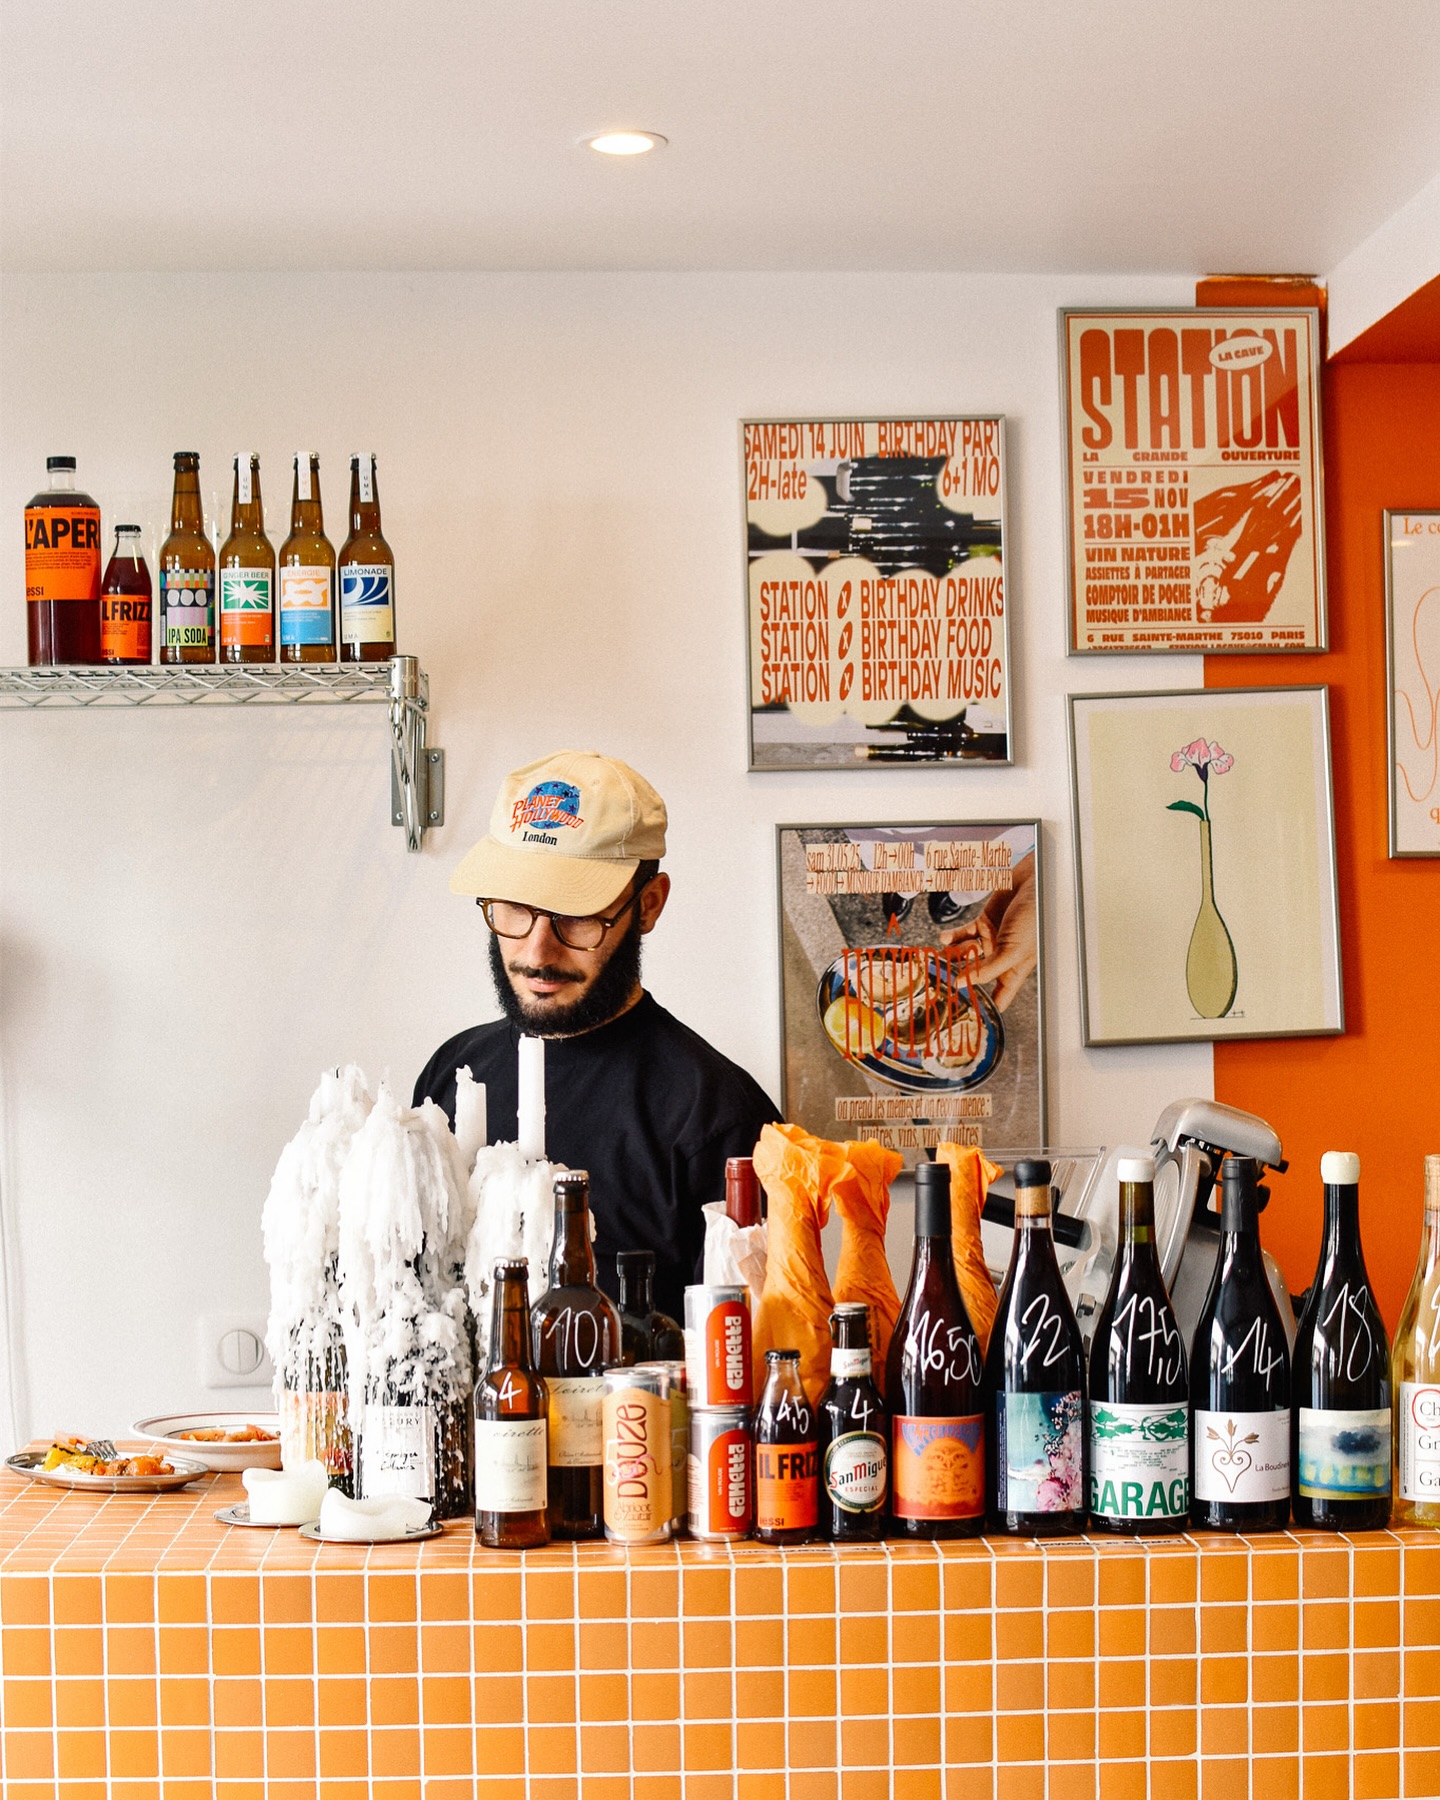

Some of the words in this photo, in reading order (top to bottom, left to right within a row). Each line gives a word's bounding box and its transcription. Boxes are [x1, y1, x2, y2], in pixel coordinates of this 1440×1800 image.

[1217, 351, 1233, 363] LA
[1234, 346, 1264, 360] CAVE
[1079, 327, 1300, 450] STATION
[744, 423, 804, 460] SAMEDI
[808, 423, 825, 459] 14
[830, 422, 865, 459] JUIN
[878, 420, 957, 458] BIRTHDAY
[1083, 452, 1099, 462] LA
[1132, 451, 1188, 462] GRANDE
[1221, 450, 1300, 461] OUVERTURE
[942, 456, 967, 497] 6+1
[972, 455, 999, 497] MO
[1083, 470, 1188, 485] VENDREDI
[1083, 487, 1150, 509] 15
[1154, 487, 1188, 509] NOV
[1084, 513, 1190, 539] 18H-01H
[1403, 515, 1423, 535] Le
[1085, 547, 1118, 563] VIN
[1121, 546, 1190, 562] NATURE
[223, 571, 250, 579] GINGER
[251, 571, 269, 579] BEER
[287, 569, 320, 577] ENERGIE
[343, 567, 387, 576] LIMONADE
[1085, 566, 1130, 581] ASSIETTES
[1134, 563, 1141, 580] À
[1145, 565, 1191, 580] PARTAGER
[26, 586, 44, 596] essi
[760, 580, 829, 622] STATION
[861, 577, 941, 619] BIRTHDAY
[945, 575, 1004, 618] DRINKS
[1086, 584, 1139, 606] COMPTOIR
[1142, 584, 1155, 605] DE
[1159, 583, 1192, 604] POCHE
[1086, 608, 1130, 624] MUSIQUE
[1133, 607, 1192, 623] D'AMBIANCE
[168, 628, 181, 644] IPA
[184, 628, 207, 644] SODA
[761, 621, 830, 663] STATION
[862, 619, 941, 661] BIRTHDAY
[946, 617, 992, 659] FOOD
[1087, 634, 1094, 643] 6
[1102, 633, 1124, 642] RUE
[1132, 632, 1223, 642] SAINTE-MARTHE
[1230, 631, 1264, 641] 75010
[1271, 631, 1305, 640] PARIS
[762, 662, 830, 704] STATION
[862, 660, 942, 702] BIRTHDAY
[947, 657, 1001, 700] MUSIC
[511, 795, 565, 819] PLANET
[509, 807, 585, 834] HOLLYWOOD
[522, 830, 558, 846] London
[807, 850, 826, 872] sam
[925, 843, 932, 869] 6
[933, 850, 948, 869] rue
[838, 1100, 848, 1120] on
[849, 1095, 872, 1126] prend
[873, 1094, 885, 1119] les
[886, 1092, 914, 1118] mêmes
[915, 1095, 923, 1118] et
[545, 1307, 598, 1371] 10
[1020, 1294, 1071, 1367] 22
[1323, 1282, 1373, 1382] 18
[1221, 1316, 1284, 1392] 14
[499, 1371, 523, 1410] 4
[550, 1377, 603, 1395] Loiret
[851, 1388, 875, 1433] 4
[493, 1425, 545, 1438] oirette
[759, 1453, 775, 1479] IL
[829, 1456, 887, 1489] SanMigue
[1255, 1464, 1264, 1472] La
[845, 1484, 878, 1493] ESPECIAL
